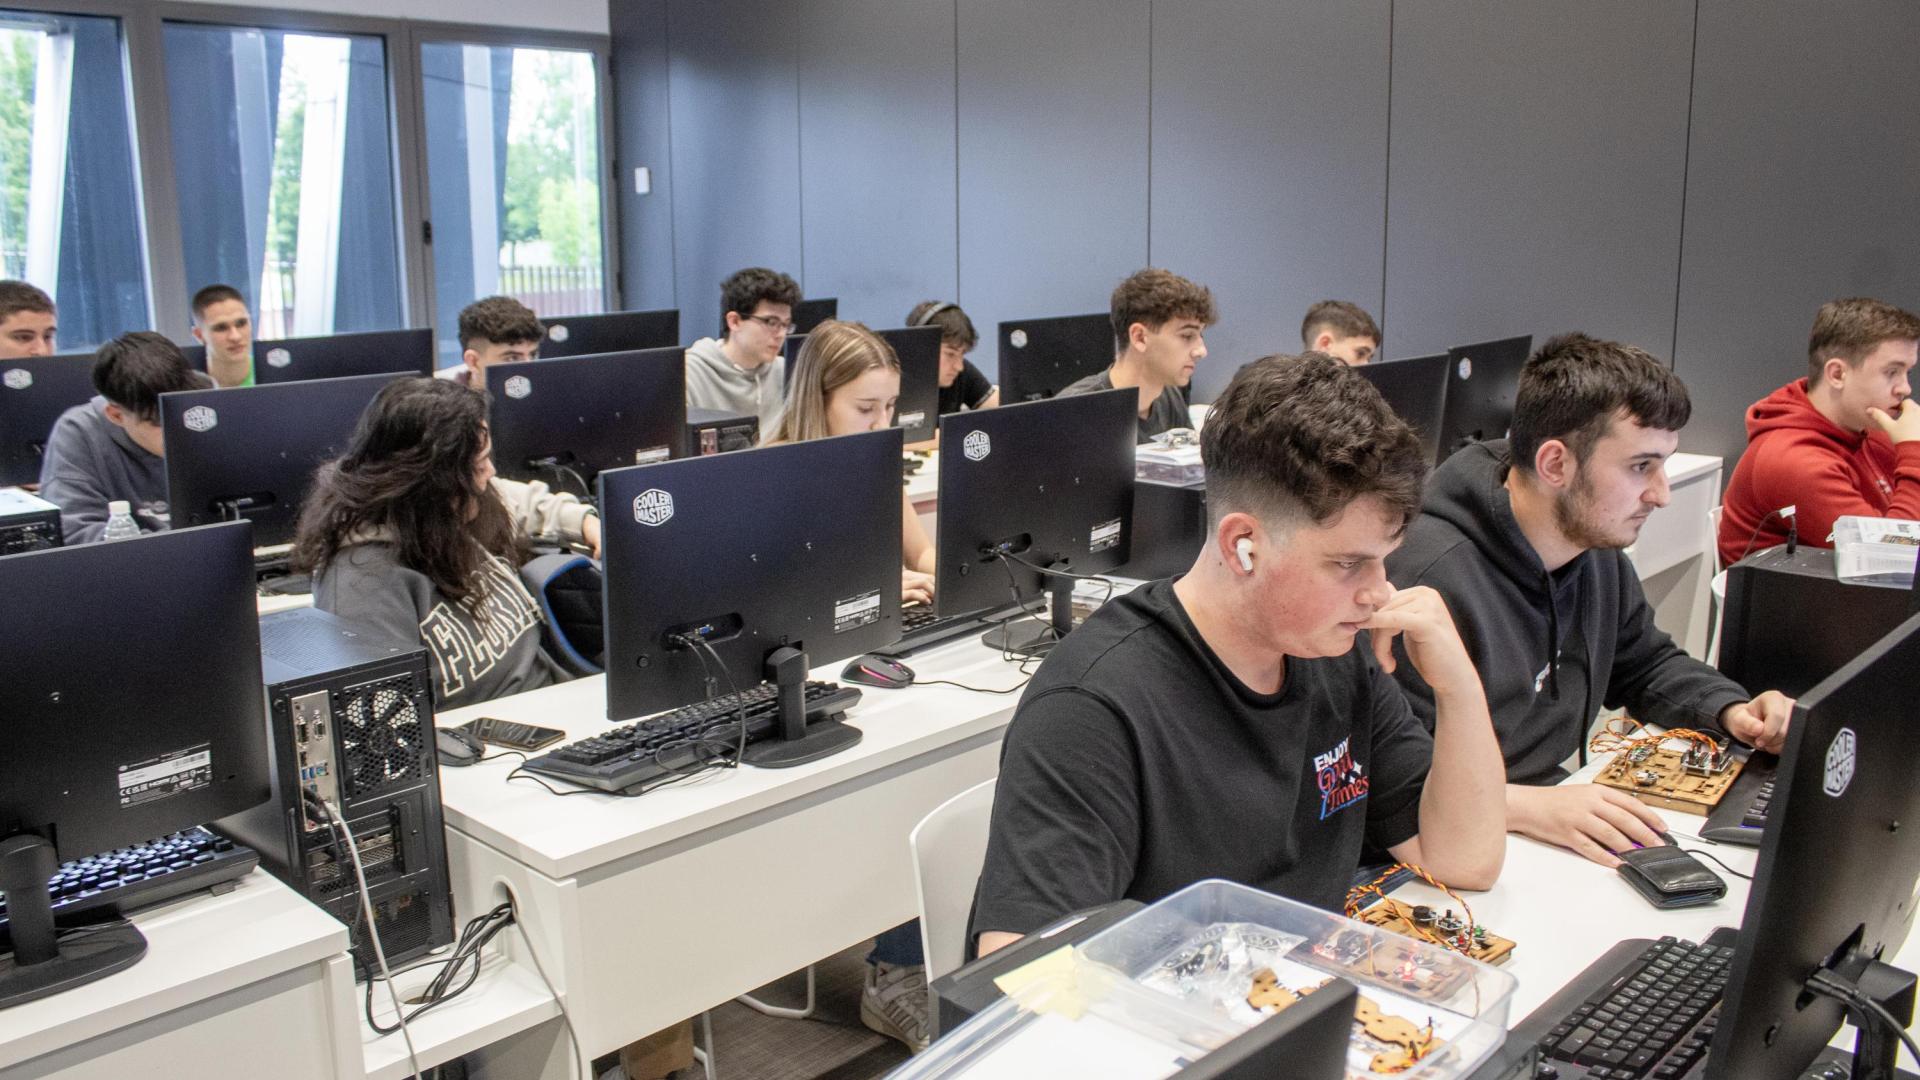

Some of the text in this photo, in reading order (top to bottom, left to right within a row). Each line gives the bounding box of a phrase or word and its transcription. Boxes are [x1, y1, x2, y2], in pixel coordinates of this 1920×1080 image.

[636, 492, 671, 509] COOLER
[637, 505, 671, 523] MASTER
[1313, 736, 1349, 773] ENJOY
[1826, 732, 1854, 771] COOLER
[1327, 775, 1369, 811] Times
